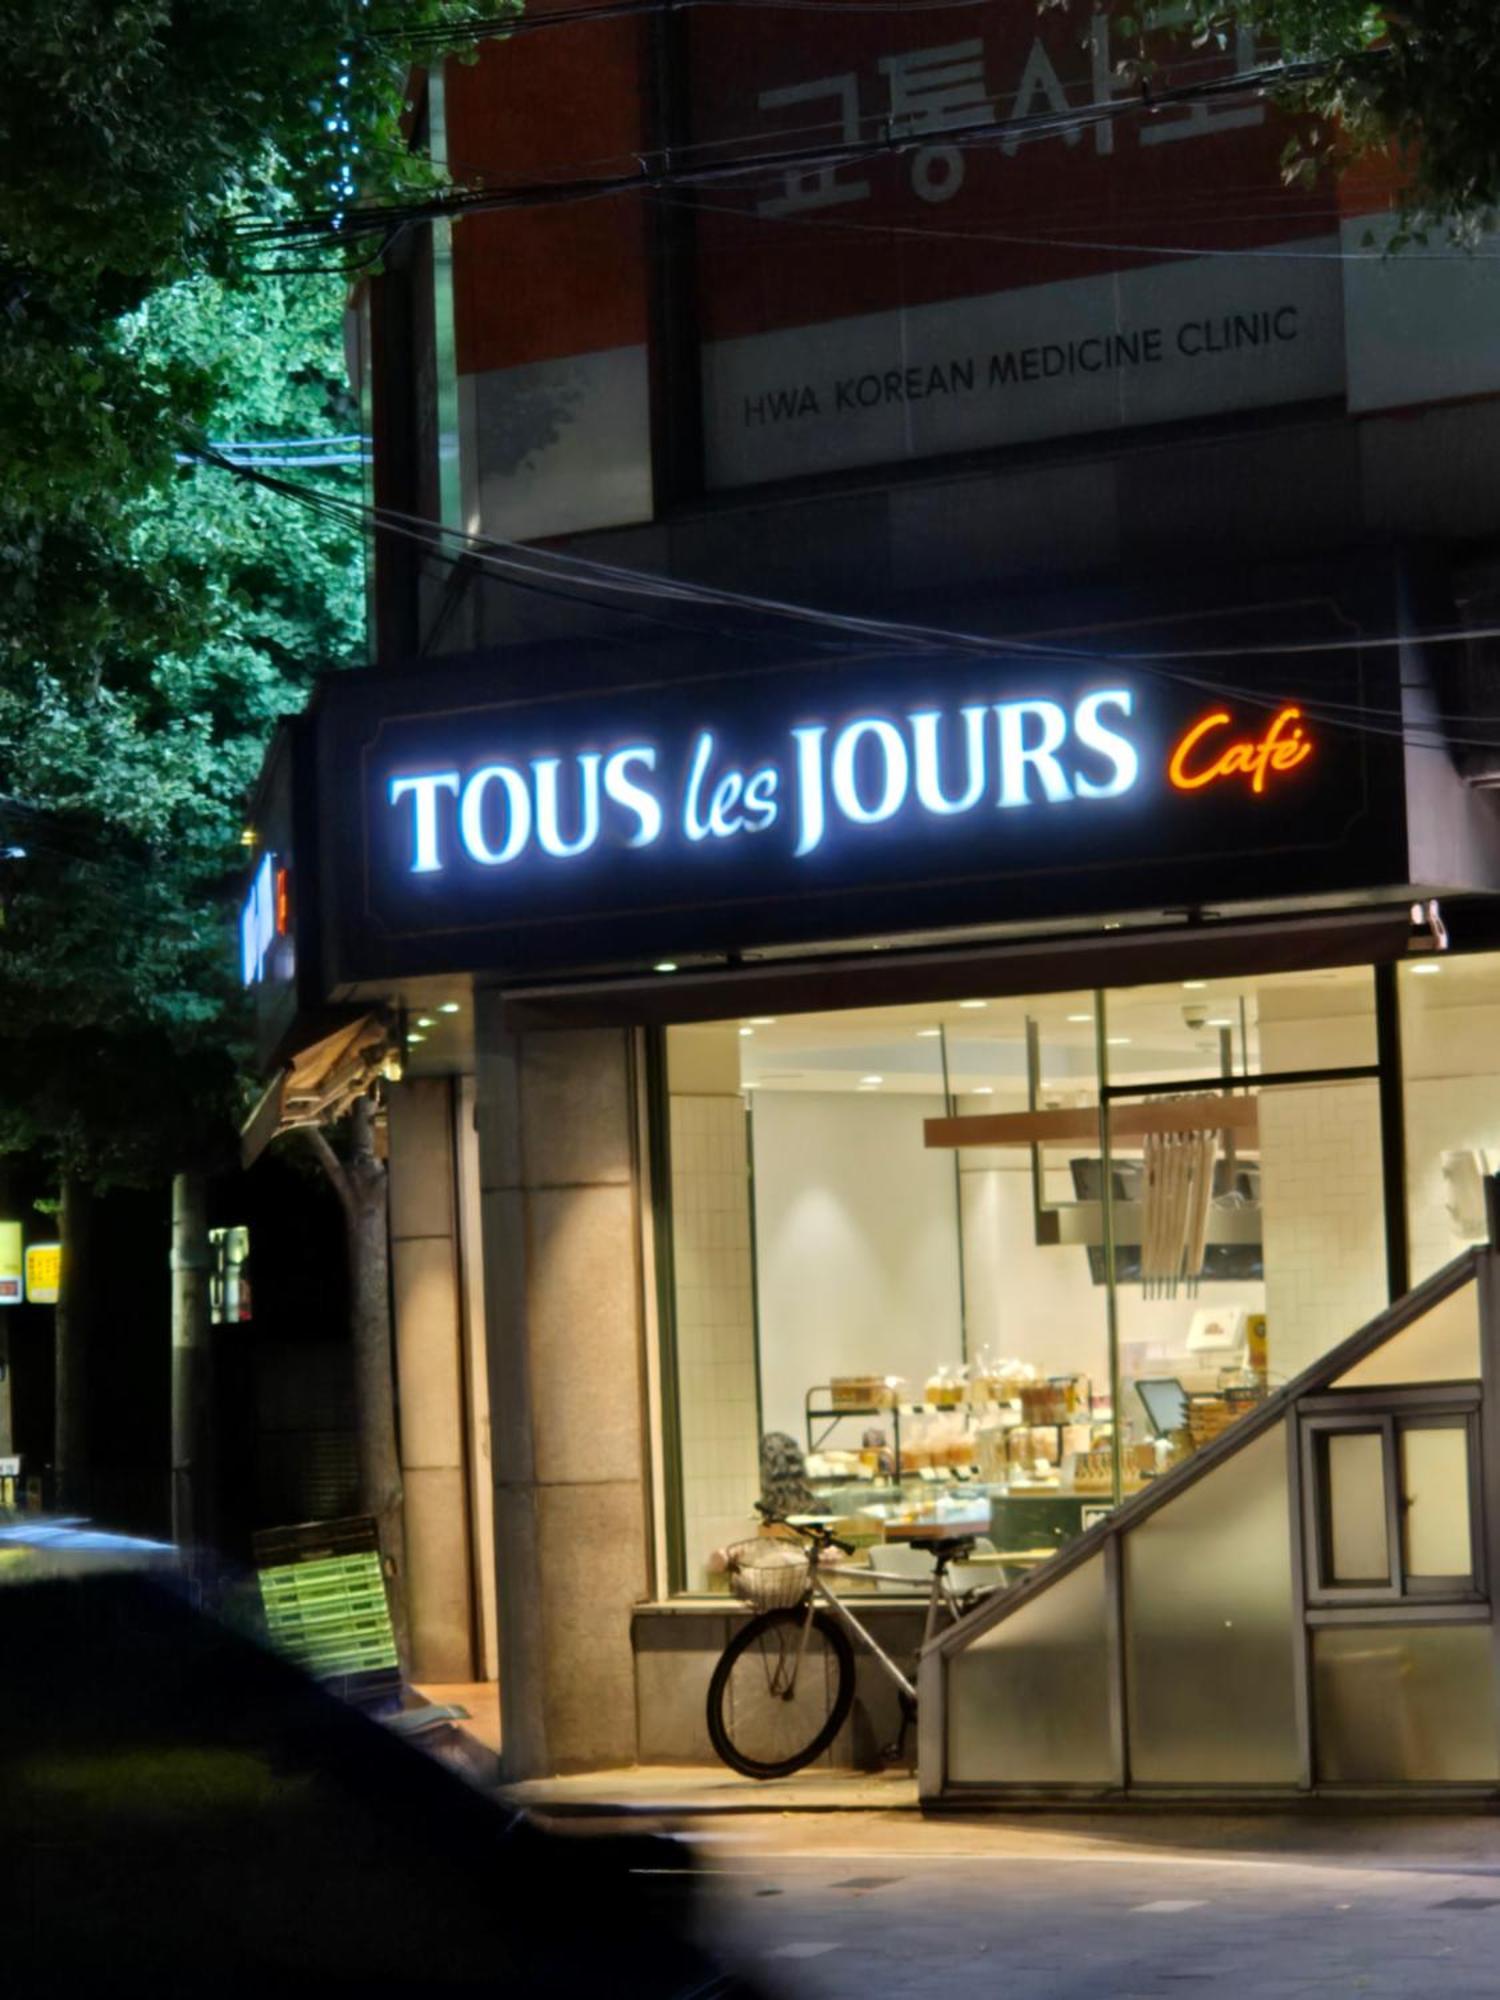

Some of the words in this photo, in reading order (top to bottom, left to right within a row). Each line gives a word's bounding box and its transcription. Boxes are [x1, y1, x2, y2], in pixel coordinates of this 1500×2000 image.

[757, 4, 1266, 218] 교통사고
[743, 386, 819, 427] HWA
[835, 360, 975, 412] KOREAN
[989, 329, 1163, 386] MEDICINE
[1177, 306, 1298, 357] CLINIC
[387, 745, 663, 873] TOUS
[683, 731, 779, 842] les
[790, 688, 1139, 858] JOURS
